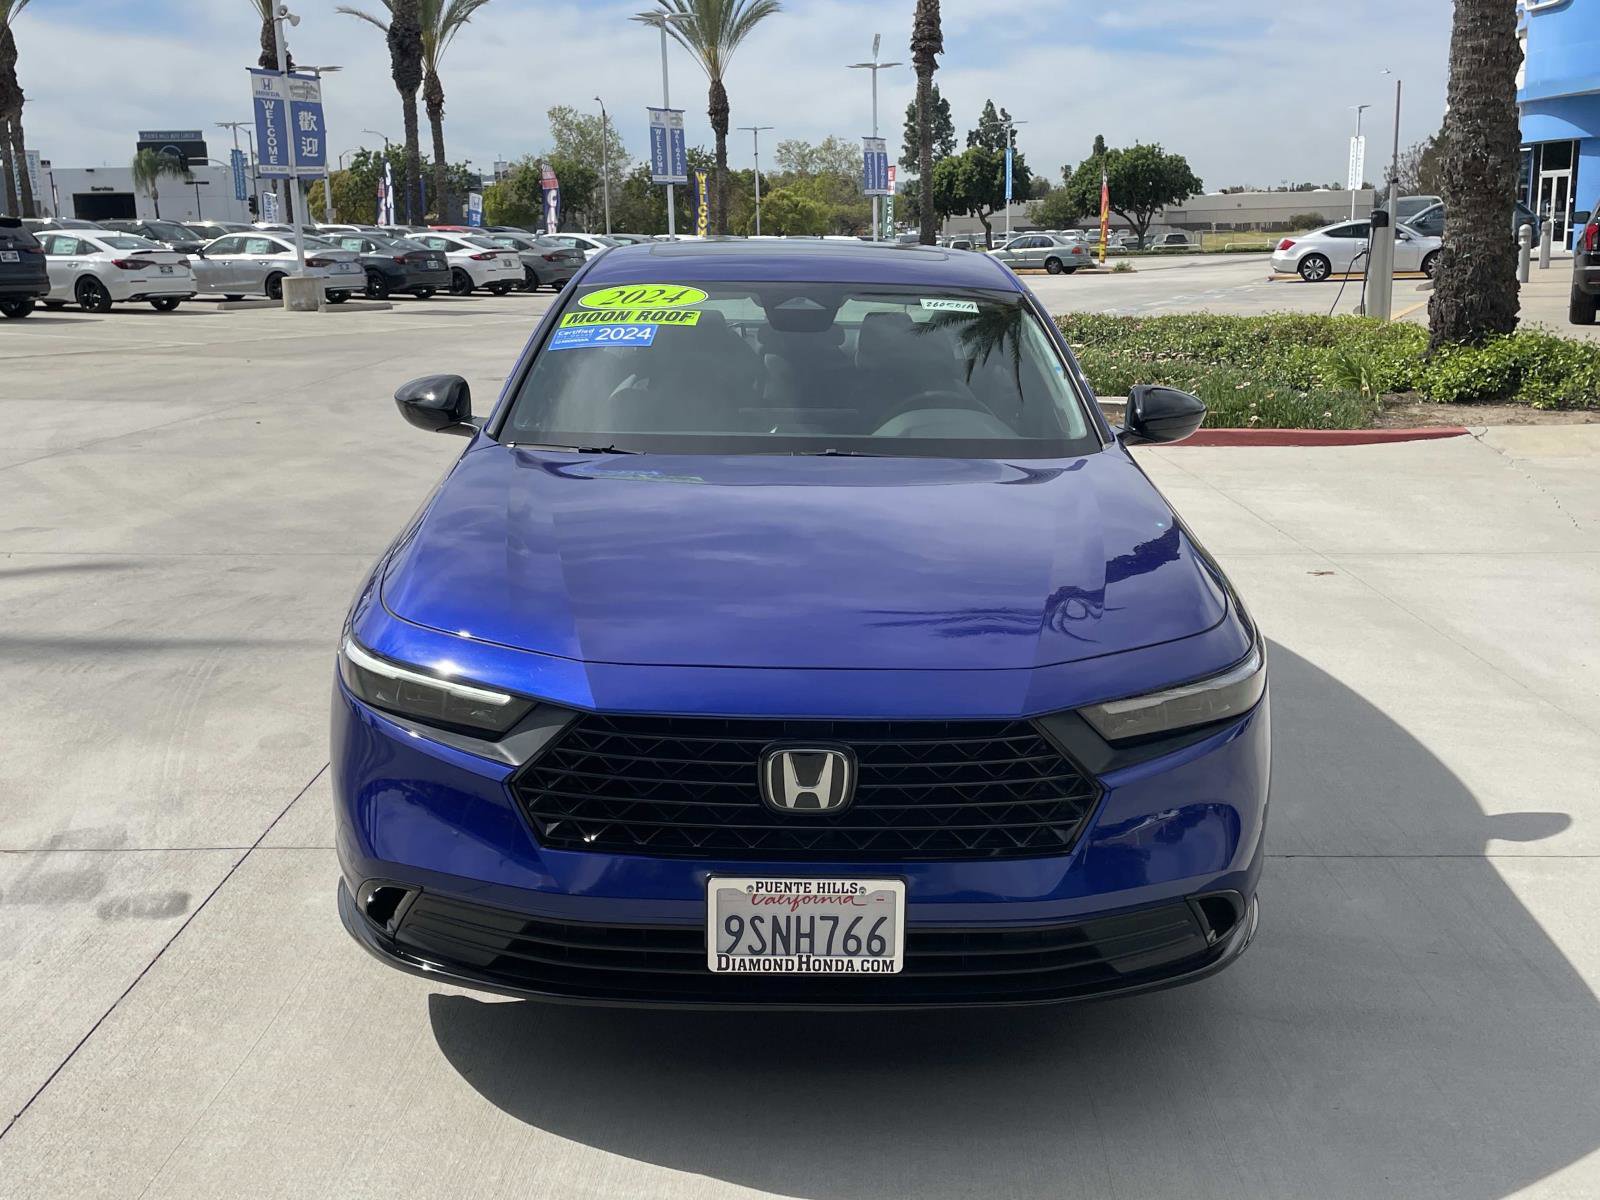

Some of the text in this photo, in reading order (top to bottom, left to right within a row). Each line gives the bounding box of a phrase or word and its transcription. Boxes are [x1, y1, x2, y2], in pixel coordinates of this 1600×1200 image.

[262, 100, 278, 164] WELCOME
[298, 111, 319, 157] 歡迎
[655, 128, 663, 175] WELCOME
[598, 289, 690, 305] 2024
[566, 310, 696, 325] MOON ROOF
[558, 328, 595, 336] Certified
[595, 327, 652, 340] 2024
[755, 881, 858, 894] PUENTE HILLS
[751, 893, 867, 912] California
[724, 914, 888, 956] 9SNH766
